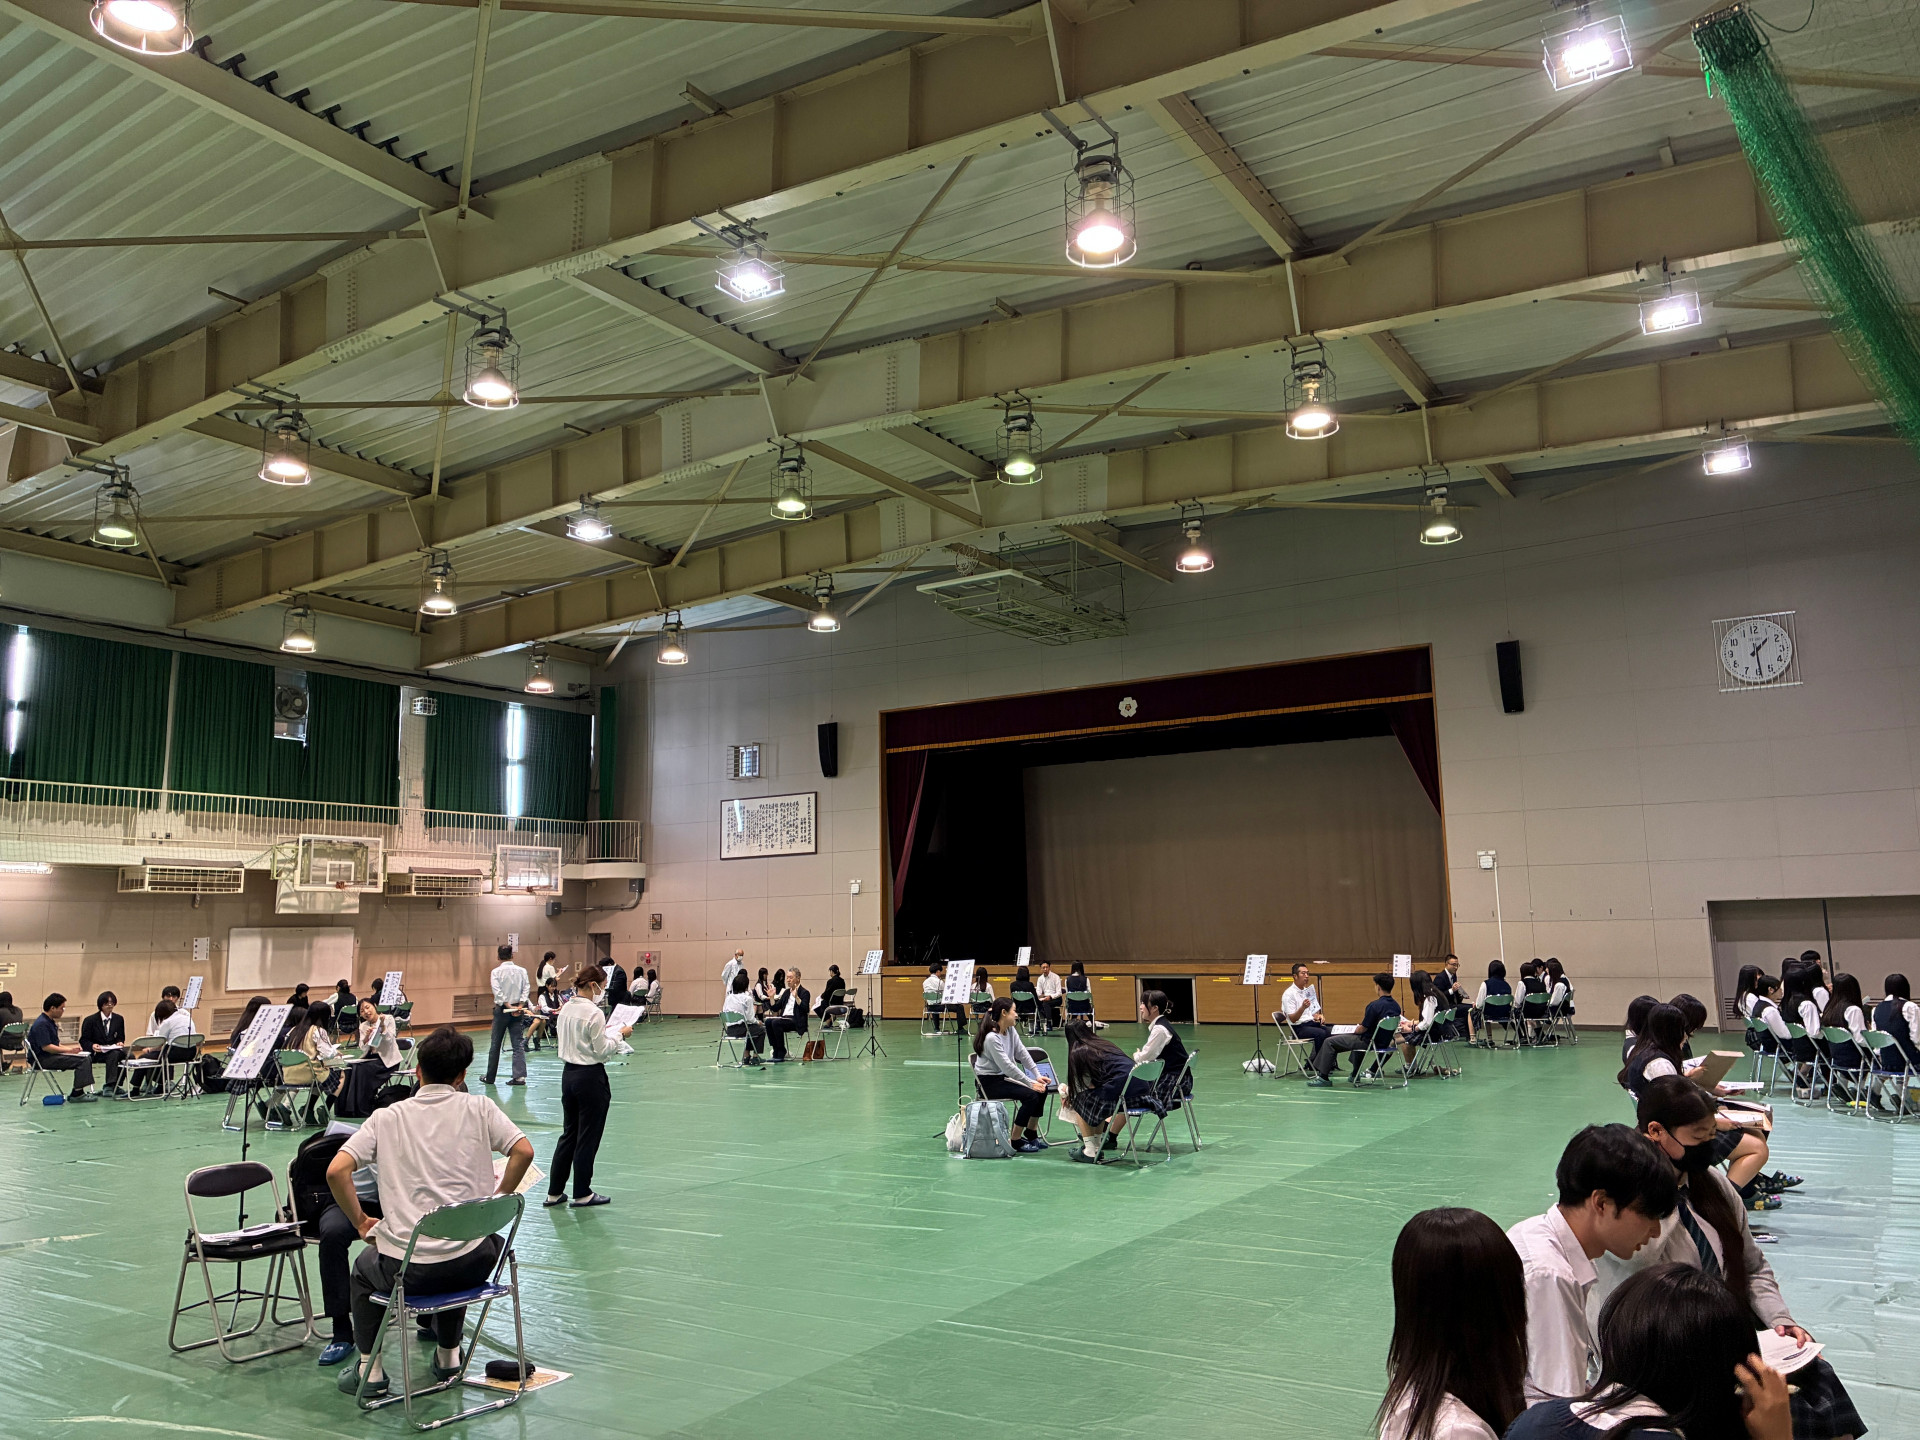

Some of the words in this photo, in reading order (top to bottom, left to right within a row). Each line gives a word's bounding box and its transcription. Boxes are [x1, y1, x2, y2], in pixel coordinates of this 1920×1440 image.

[1750, 625, 1759, 634] 12
[1774, 634, 1780, 642] 2
[1730, 638, 1738, 647] 10
[1727, 650, 1734, 658] 9
[1744, 667, 1750, 675] 7
